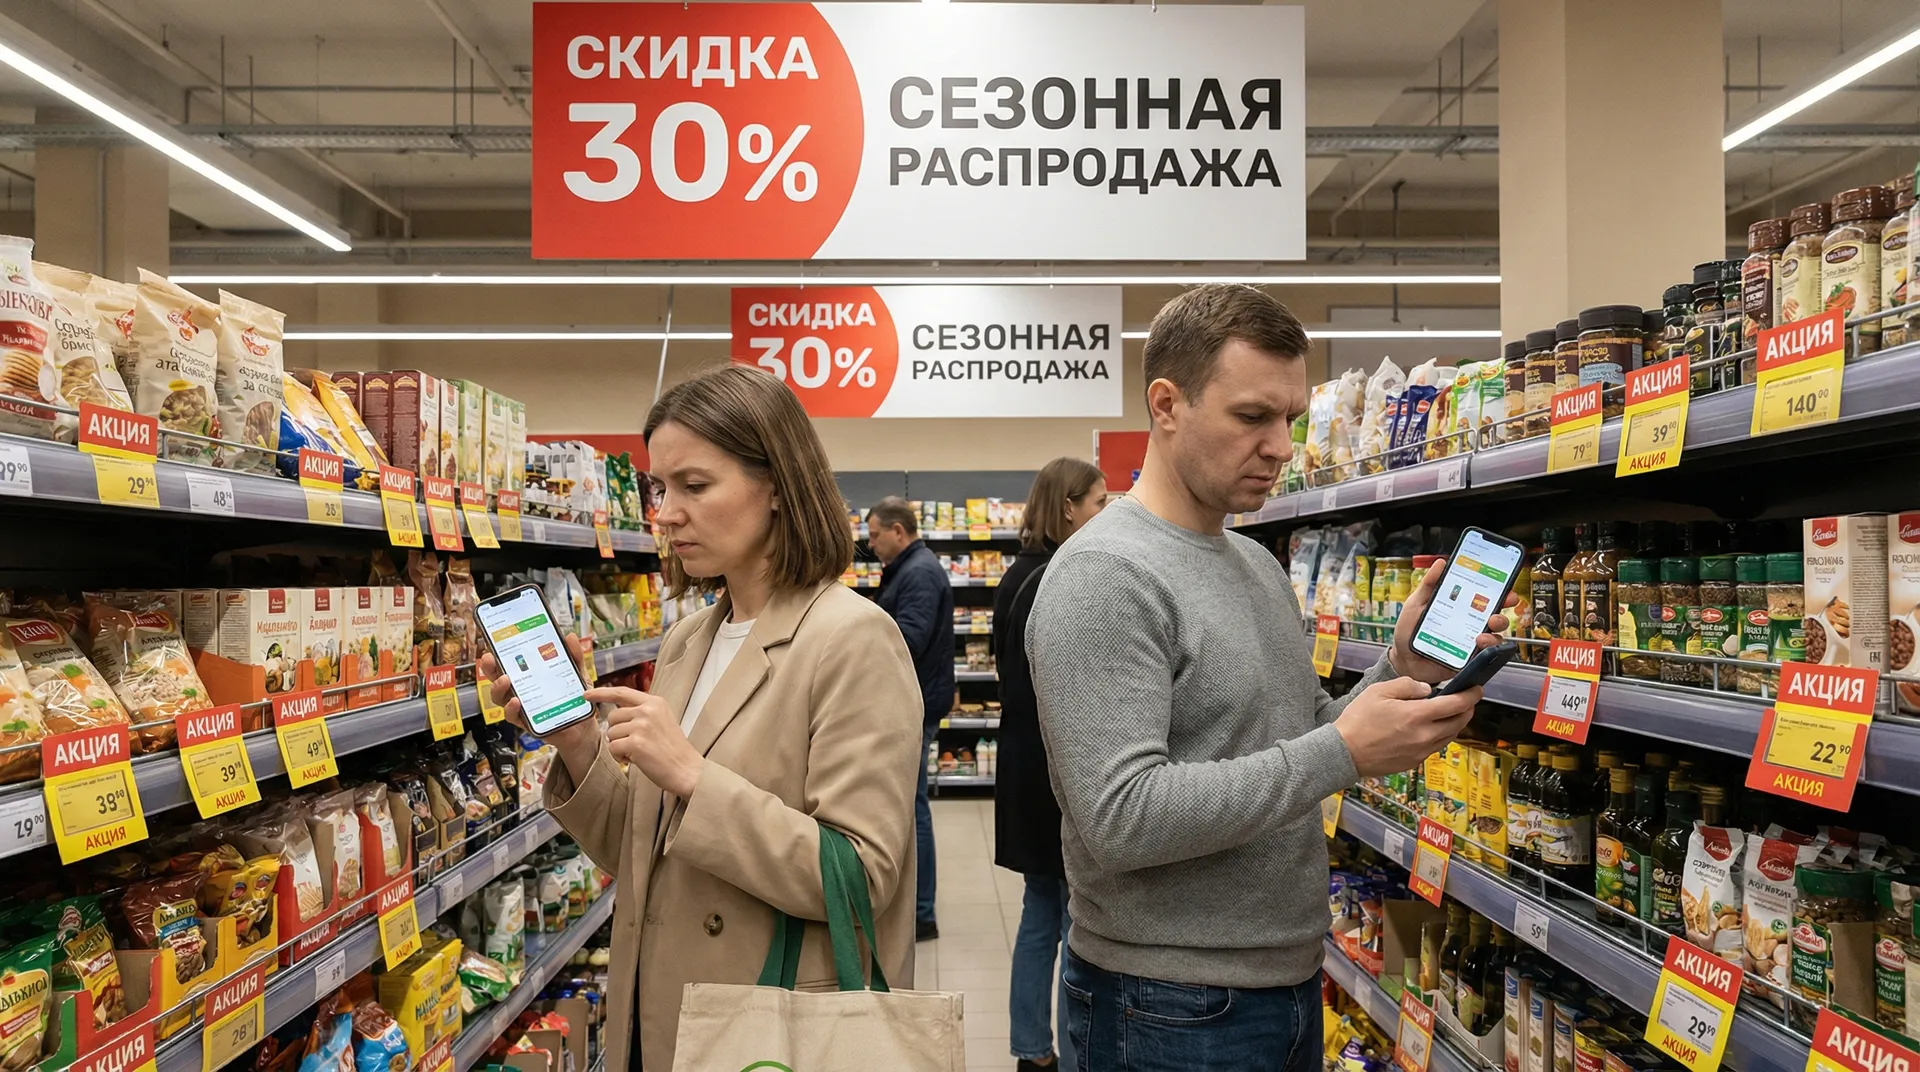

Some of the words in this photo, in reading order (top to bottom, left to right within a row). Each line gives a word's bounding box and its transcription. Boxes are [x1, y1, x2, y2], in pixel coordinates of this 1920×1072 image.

[567, 35, 819, 87] СКИДКА
[889, 76, 1282, 130] СЕЗОННАЯ
[563, 101, 819, 203] 30%
[889, 147, 1282, 194] РАСПРОДАЖА
[748, 303, 876, 330] СКИДКА
[912, 323, 1110, 351] СЕЗОННАЯ
[1765, 319, 1834, 361] АКЦИЯ
[749, 336, 877, 389] 30%
[912, 360, 1110, 384] РАСПРОДАЖА
[1631, 364, 1682, 398] АКЦИЯ
[1555, 390, 1596, 418] АКЦИЯ
[1786, 393, 1817, 416] 140
[87, 412, 150, 446] АКЦИЯ
[1652, 425, 1668, 443] 39
[1573, 444, 1585, 460] 79
[1629, 452, 1666, 471] АКЦИЯ
[304, 455, 339, 478] АКЦИЯ
[127, 477, 145, 494] 29
[384, 471, 411, 491] АКЦИЯ
[1554, 646, 1596, 669] АКЦИЯ
[1561, 694, 1580, 711] 449
[1788, 672, 1865, 706] АКЦИЯ
[280, 696, 318, 719] АКЦИЯ
[186, 711, 235, 739] АКЦИЯ
[54, 732, 120, 767] АКЦИЯ
[1810, 741, 1836, 764] 22
[220, 764, 236, 783] 39
[302, 764, 327, 781] АКЦИЯ
[1773, 773, 1825, 797] АКЦИЯ
[216, 789, 246, 809] АКЦИЯ
[86, 826, 127, 851] АКЦИЯ
[381, 880, 410, 910] АКЦИЯ
[1674, 948, 1733, 993] АКЦИЯ
[212, 972, 258, 1016] АКЦИЯ
[1688, 1016, 1706, 1039] 29
[84, 1035, 145, 1072] АКЦИЯ
[1662, 1035, 1697, 1064] АКЦИЯ
[1826, 1025, 1910, 1072] АКЦИЯ
